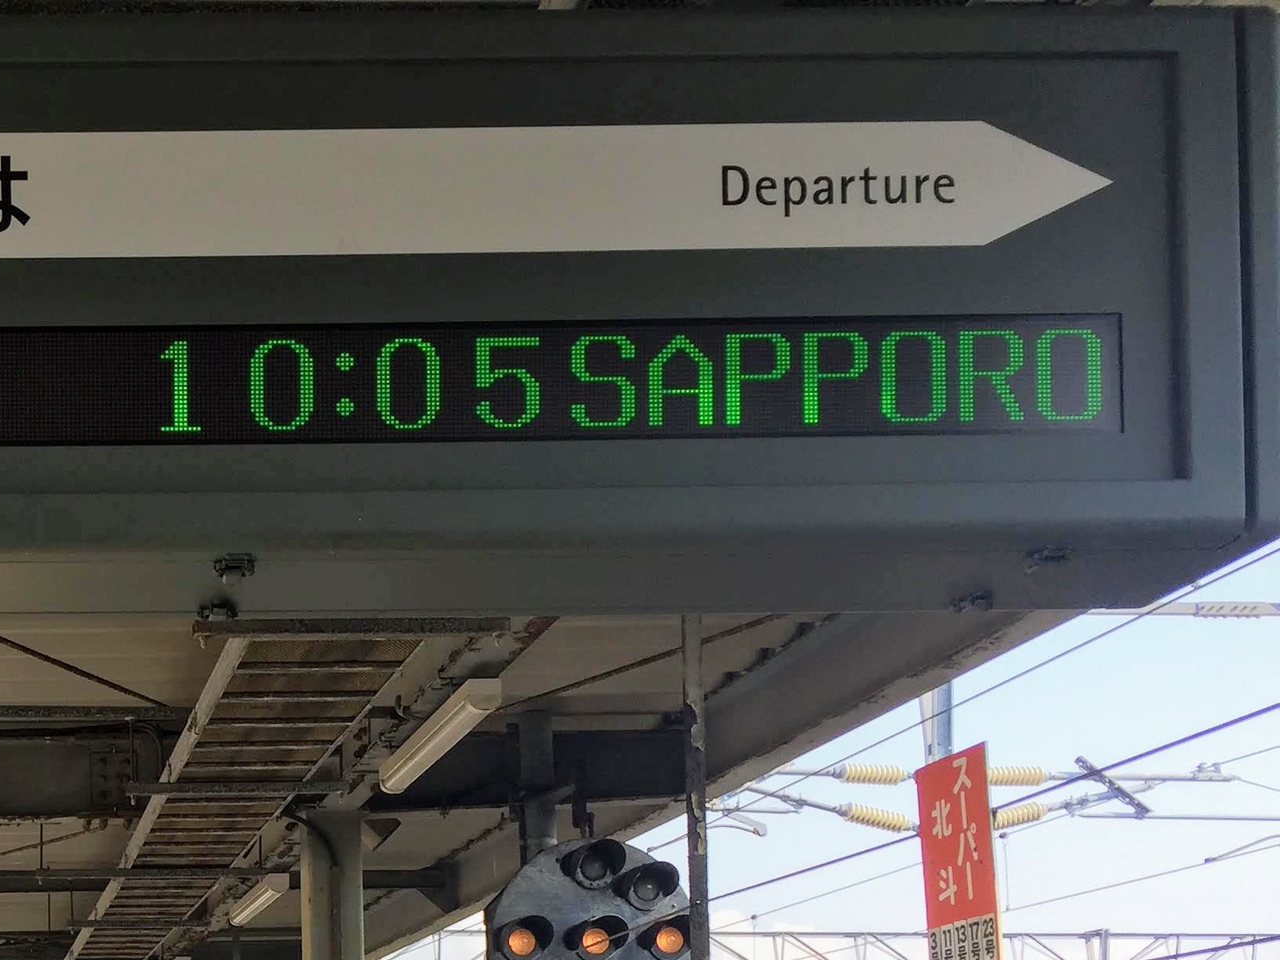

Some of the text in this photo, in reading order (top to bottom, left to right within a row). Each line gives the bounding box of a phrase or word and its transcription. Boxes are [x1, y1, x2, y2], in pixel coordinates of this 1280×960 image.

[722, 165, 955, 217] Departure
[572, 330, 1100, 426] SAPPORO
[931, 799, 958, 905] 北斗
[952, 757, 978, 900] スーパー
